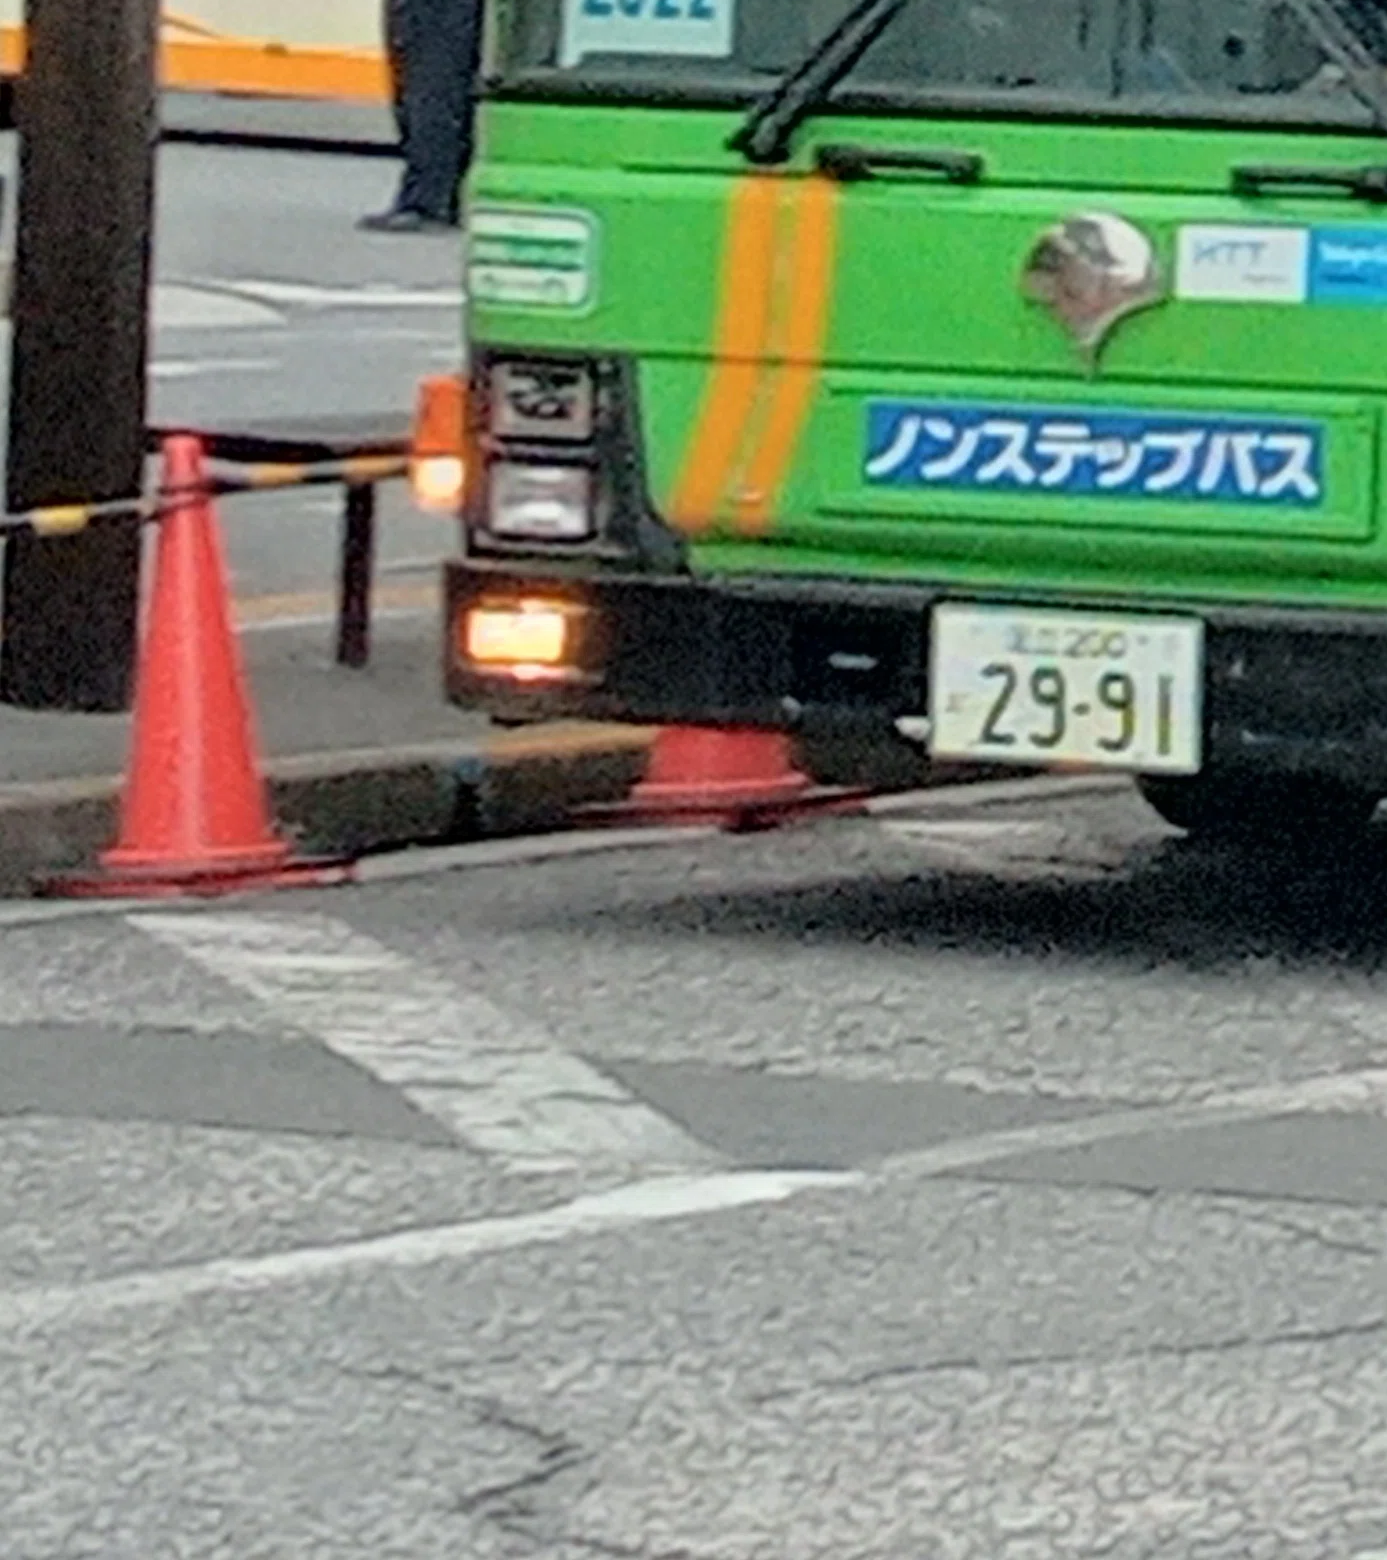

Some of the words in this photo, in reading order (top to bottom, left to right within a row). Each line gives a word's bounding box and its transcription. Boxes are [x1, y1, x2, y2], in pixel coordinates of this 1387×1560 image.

[865, 415, 1319, 499] ノンステップバス
[979, 661, 1176, 757] 29-91
